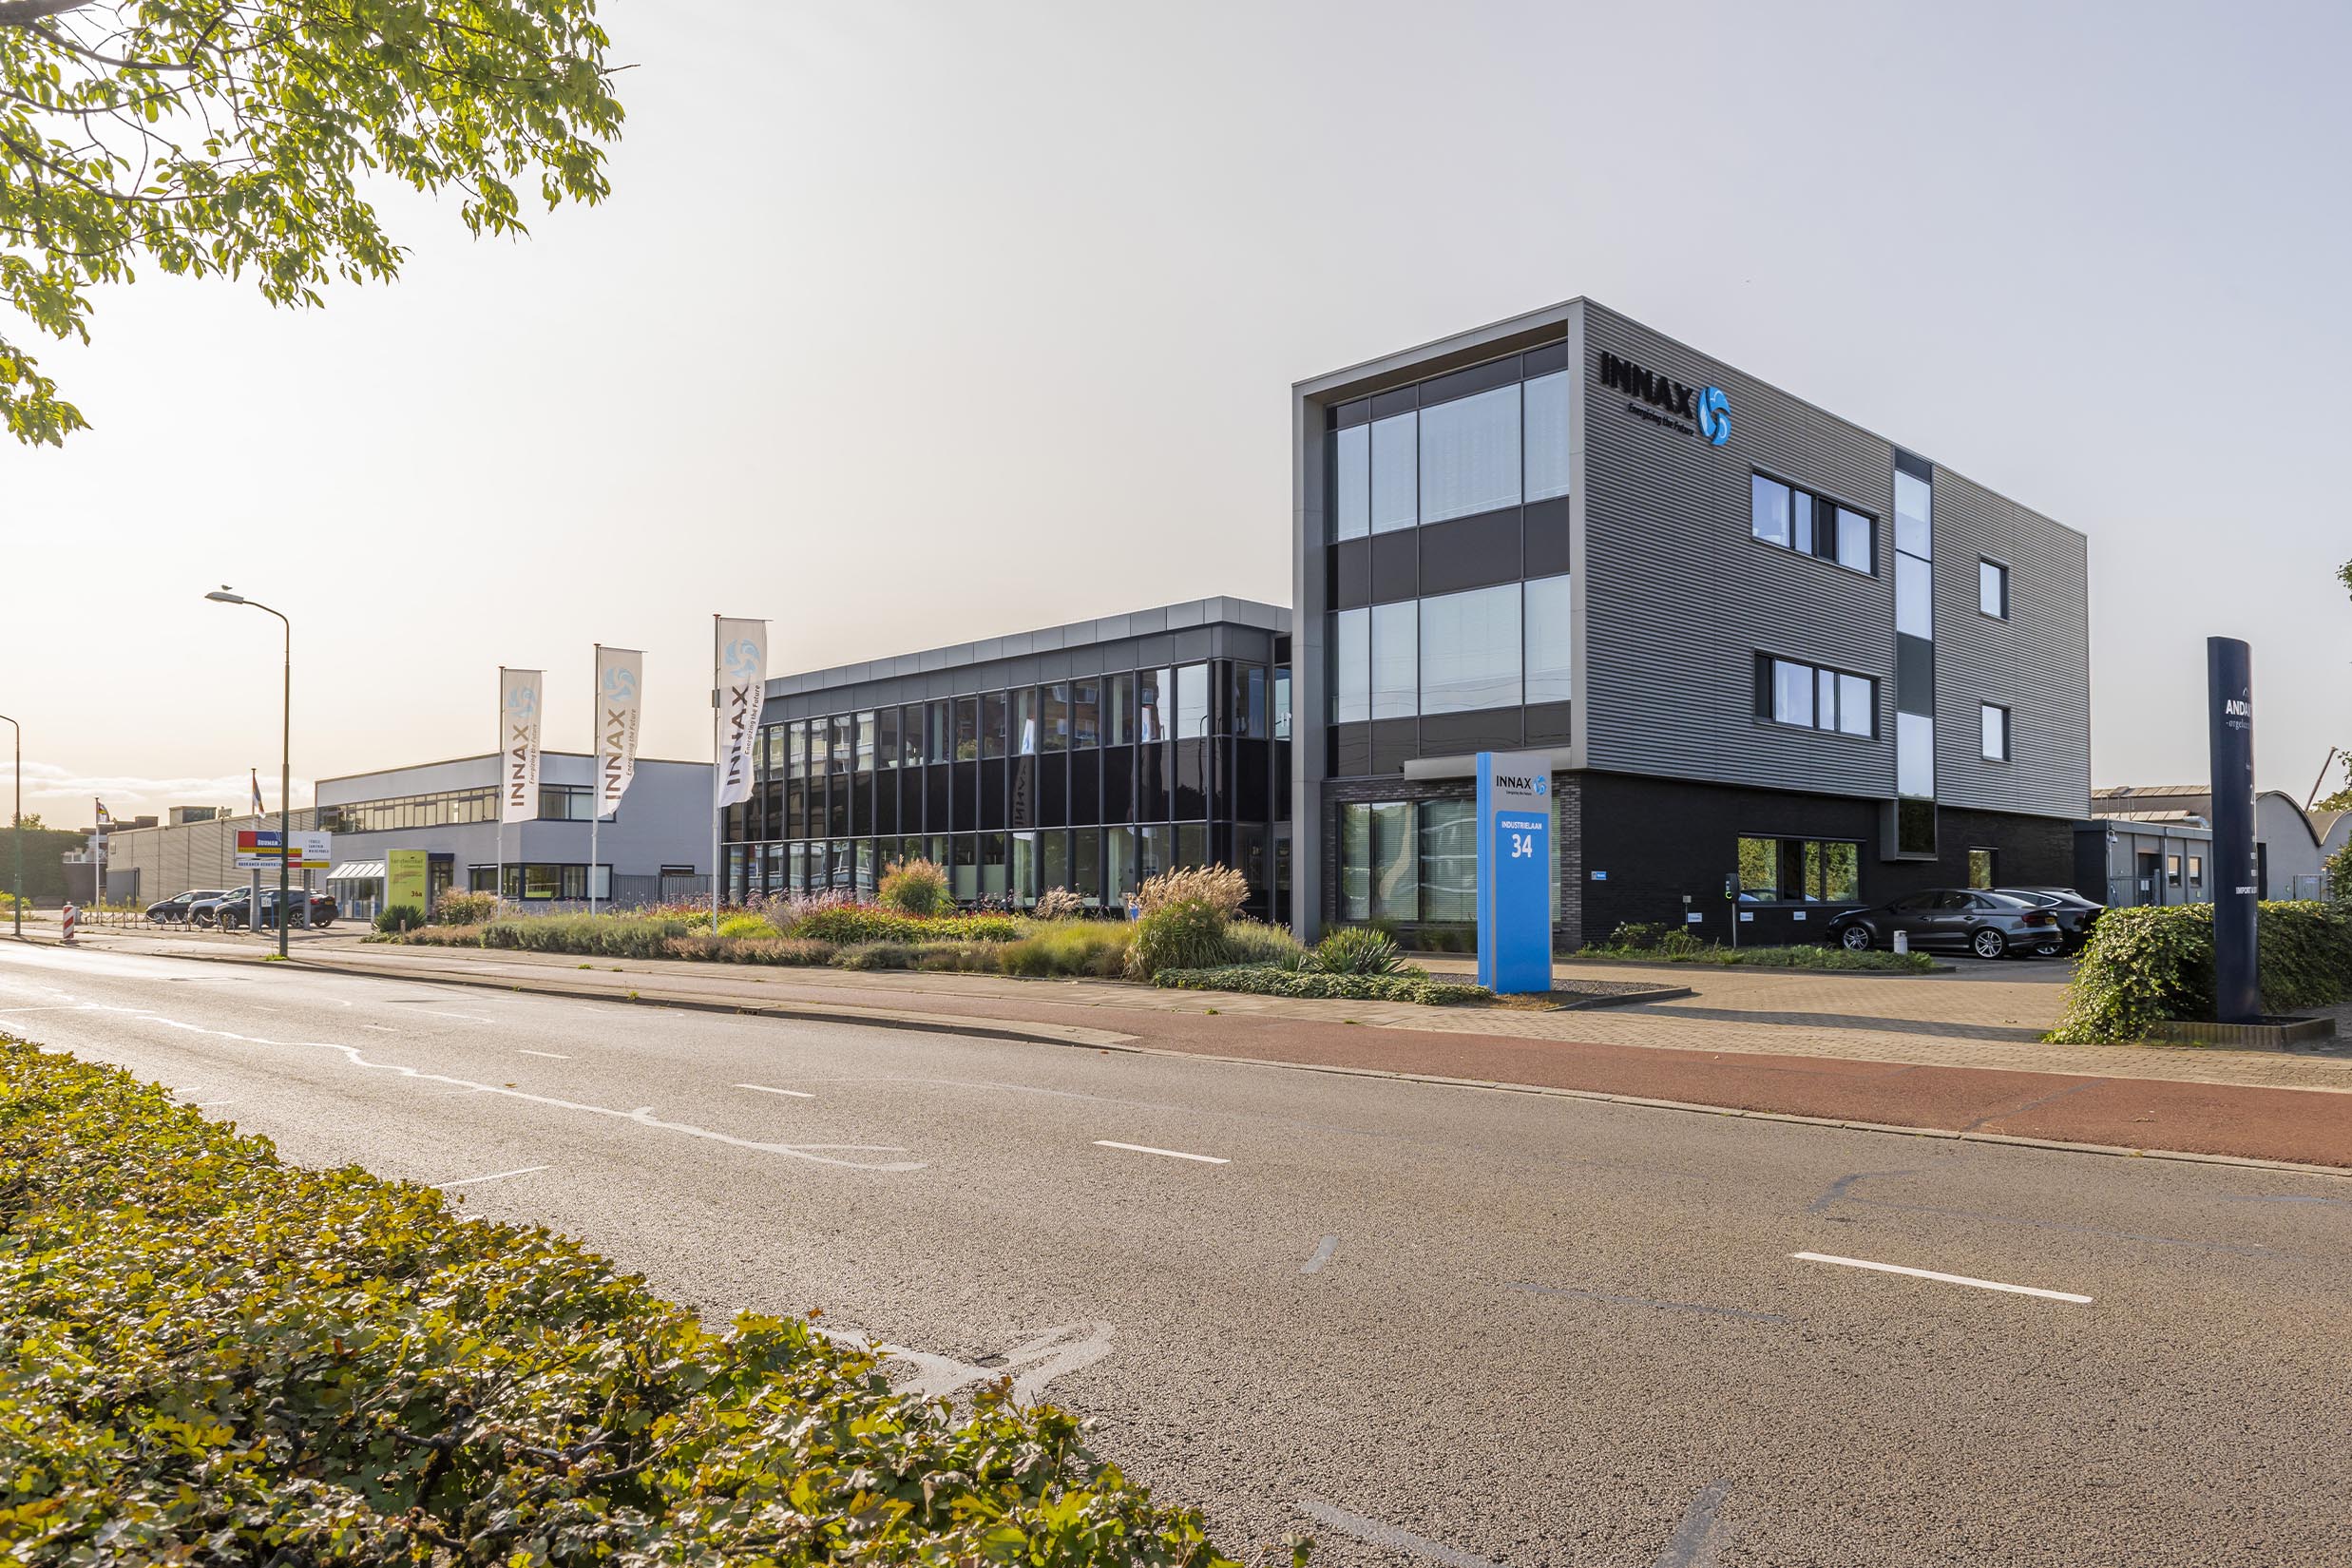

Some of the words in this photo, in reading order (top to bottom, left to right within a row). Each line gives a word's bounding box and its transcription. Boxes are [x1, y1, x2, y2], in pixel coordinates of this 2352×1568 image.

[1600, 351, 1694, 419] INNAX
[752, 684, 761, 708] Future
[750, 707, 758, 720] the
[726, 685, 749, 786] INNAX
[744, 719, 756, 755] Energizing
[510, 724, 529, 806] INNAX
[605, 708, 625, 800] INNAX
[1496, 774, 1532, 790] INNAX
[1501, 820, 1542, 830] INDUSTRIELAAN
[1511, 833, 1533, 858] 34
